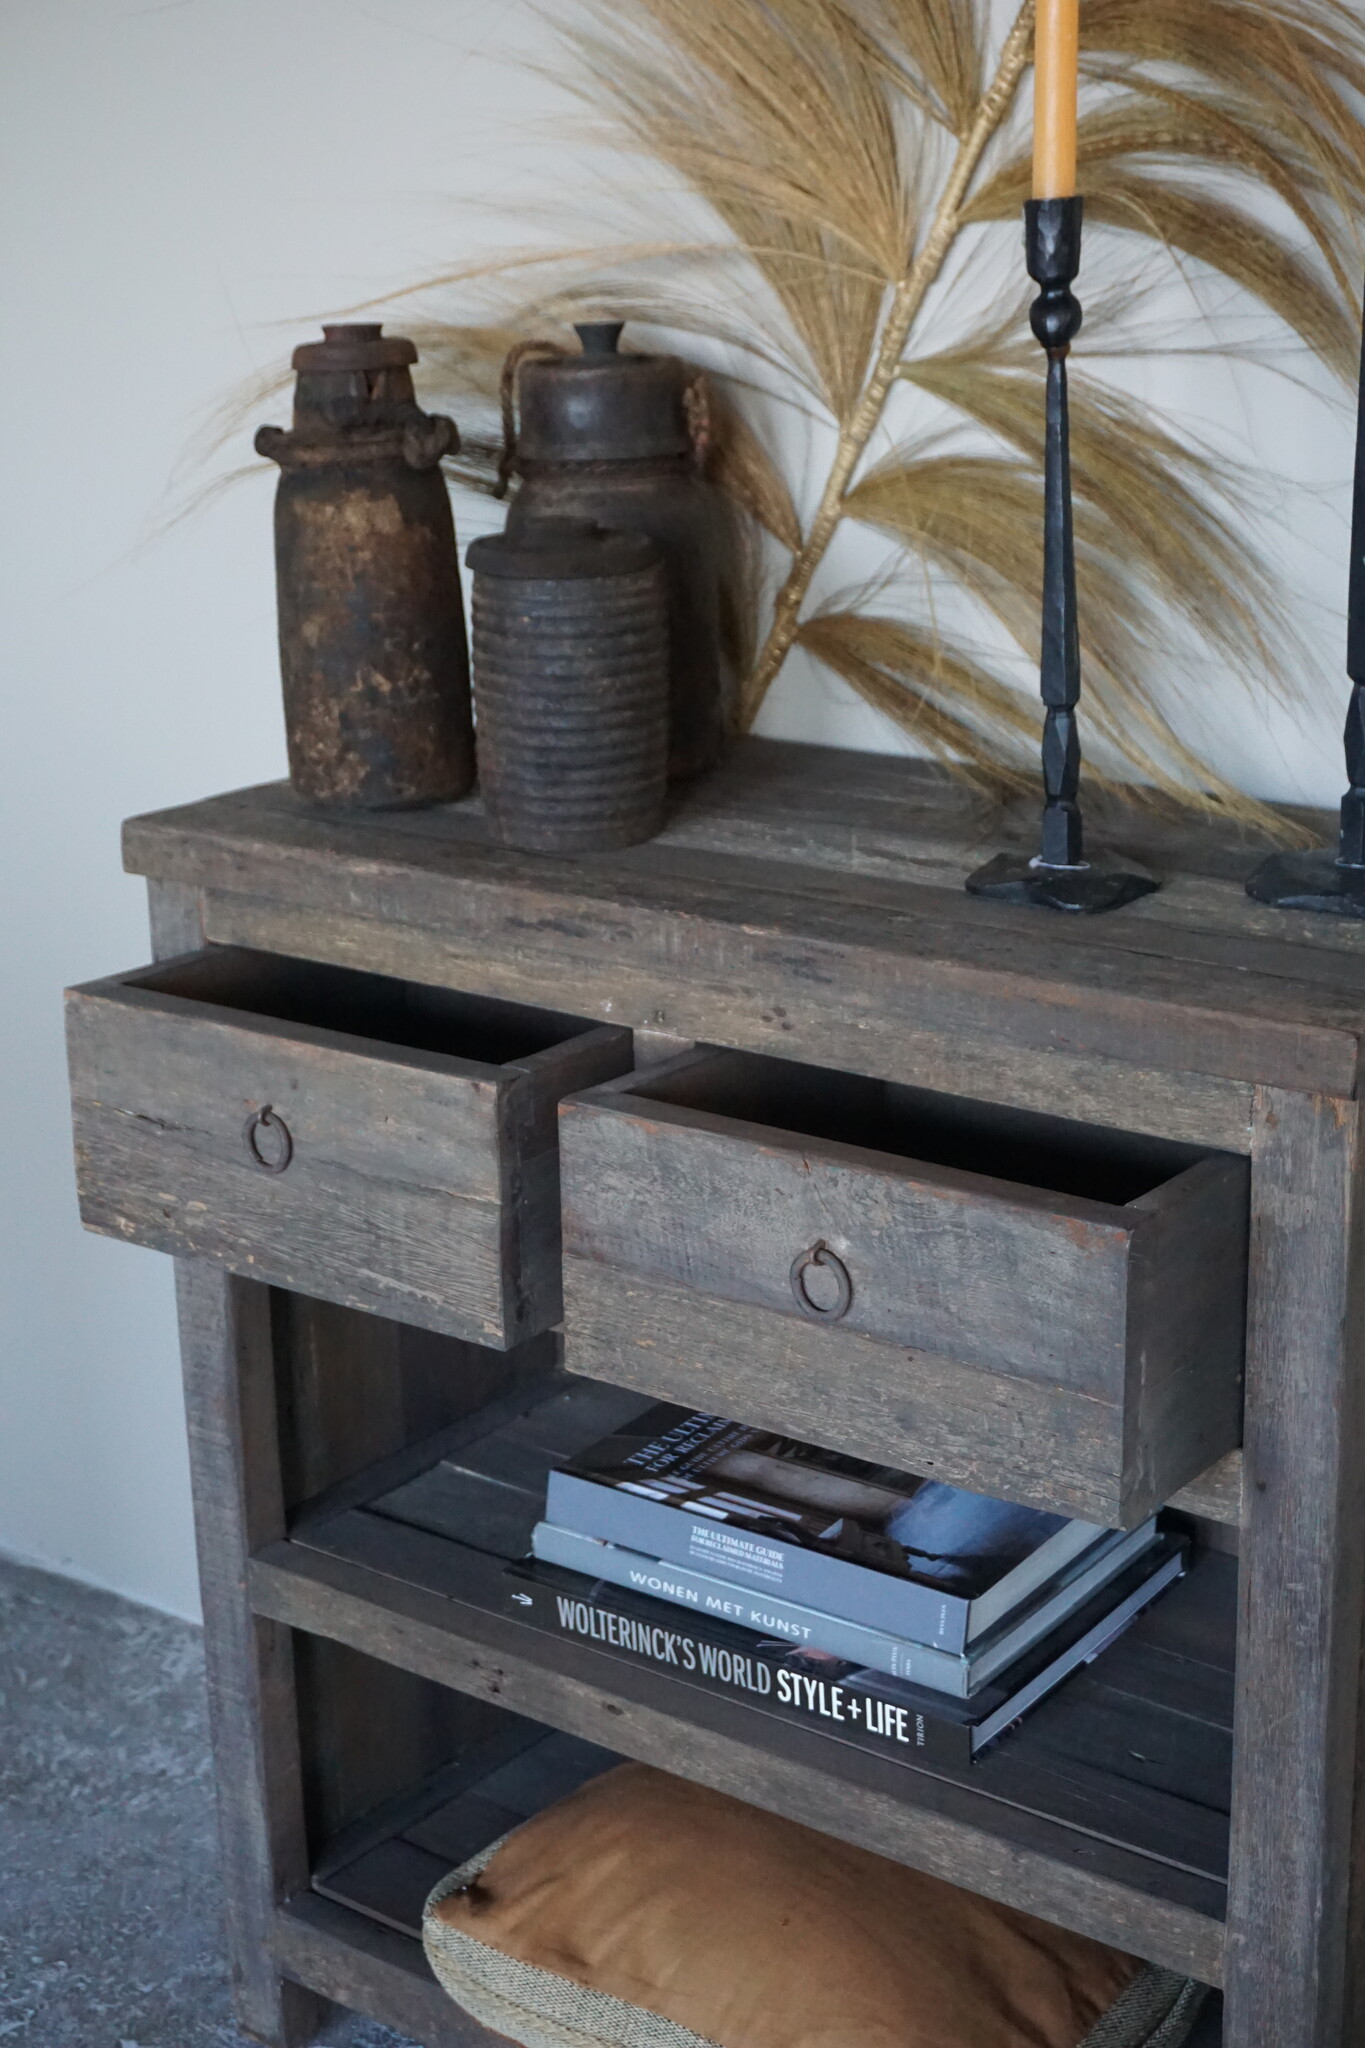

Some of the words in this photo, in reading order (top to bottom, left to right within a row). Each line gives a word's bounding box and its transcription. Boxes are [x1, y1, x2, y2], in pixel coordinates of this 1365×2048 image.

[622, 1441, 671, 1466] THE
[644, 1453, 679, 1472] FOR
[691, 1525, 709, 1538] THE
[710, 1531, 755, 1552] ULTIMATE
[755, 1545, 785, 1562] GUIDE
[630, 1570, 699, 1603] WONEN
[705, 1595, 744, 1617] MET
[751, 1610, 812, 1640] KUNST
[556, 1596, 697, 1671] WOLTERINCK'S
[698, 1642, 771, 1695] WORLD
[915, 1713, 925, 1747] TIRION
